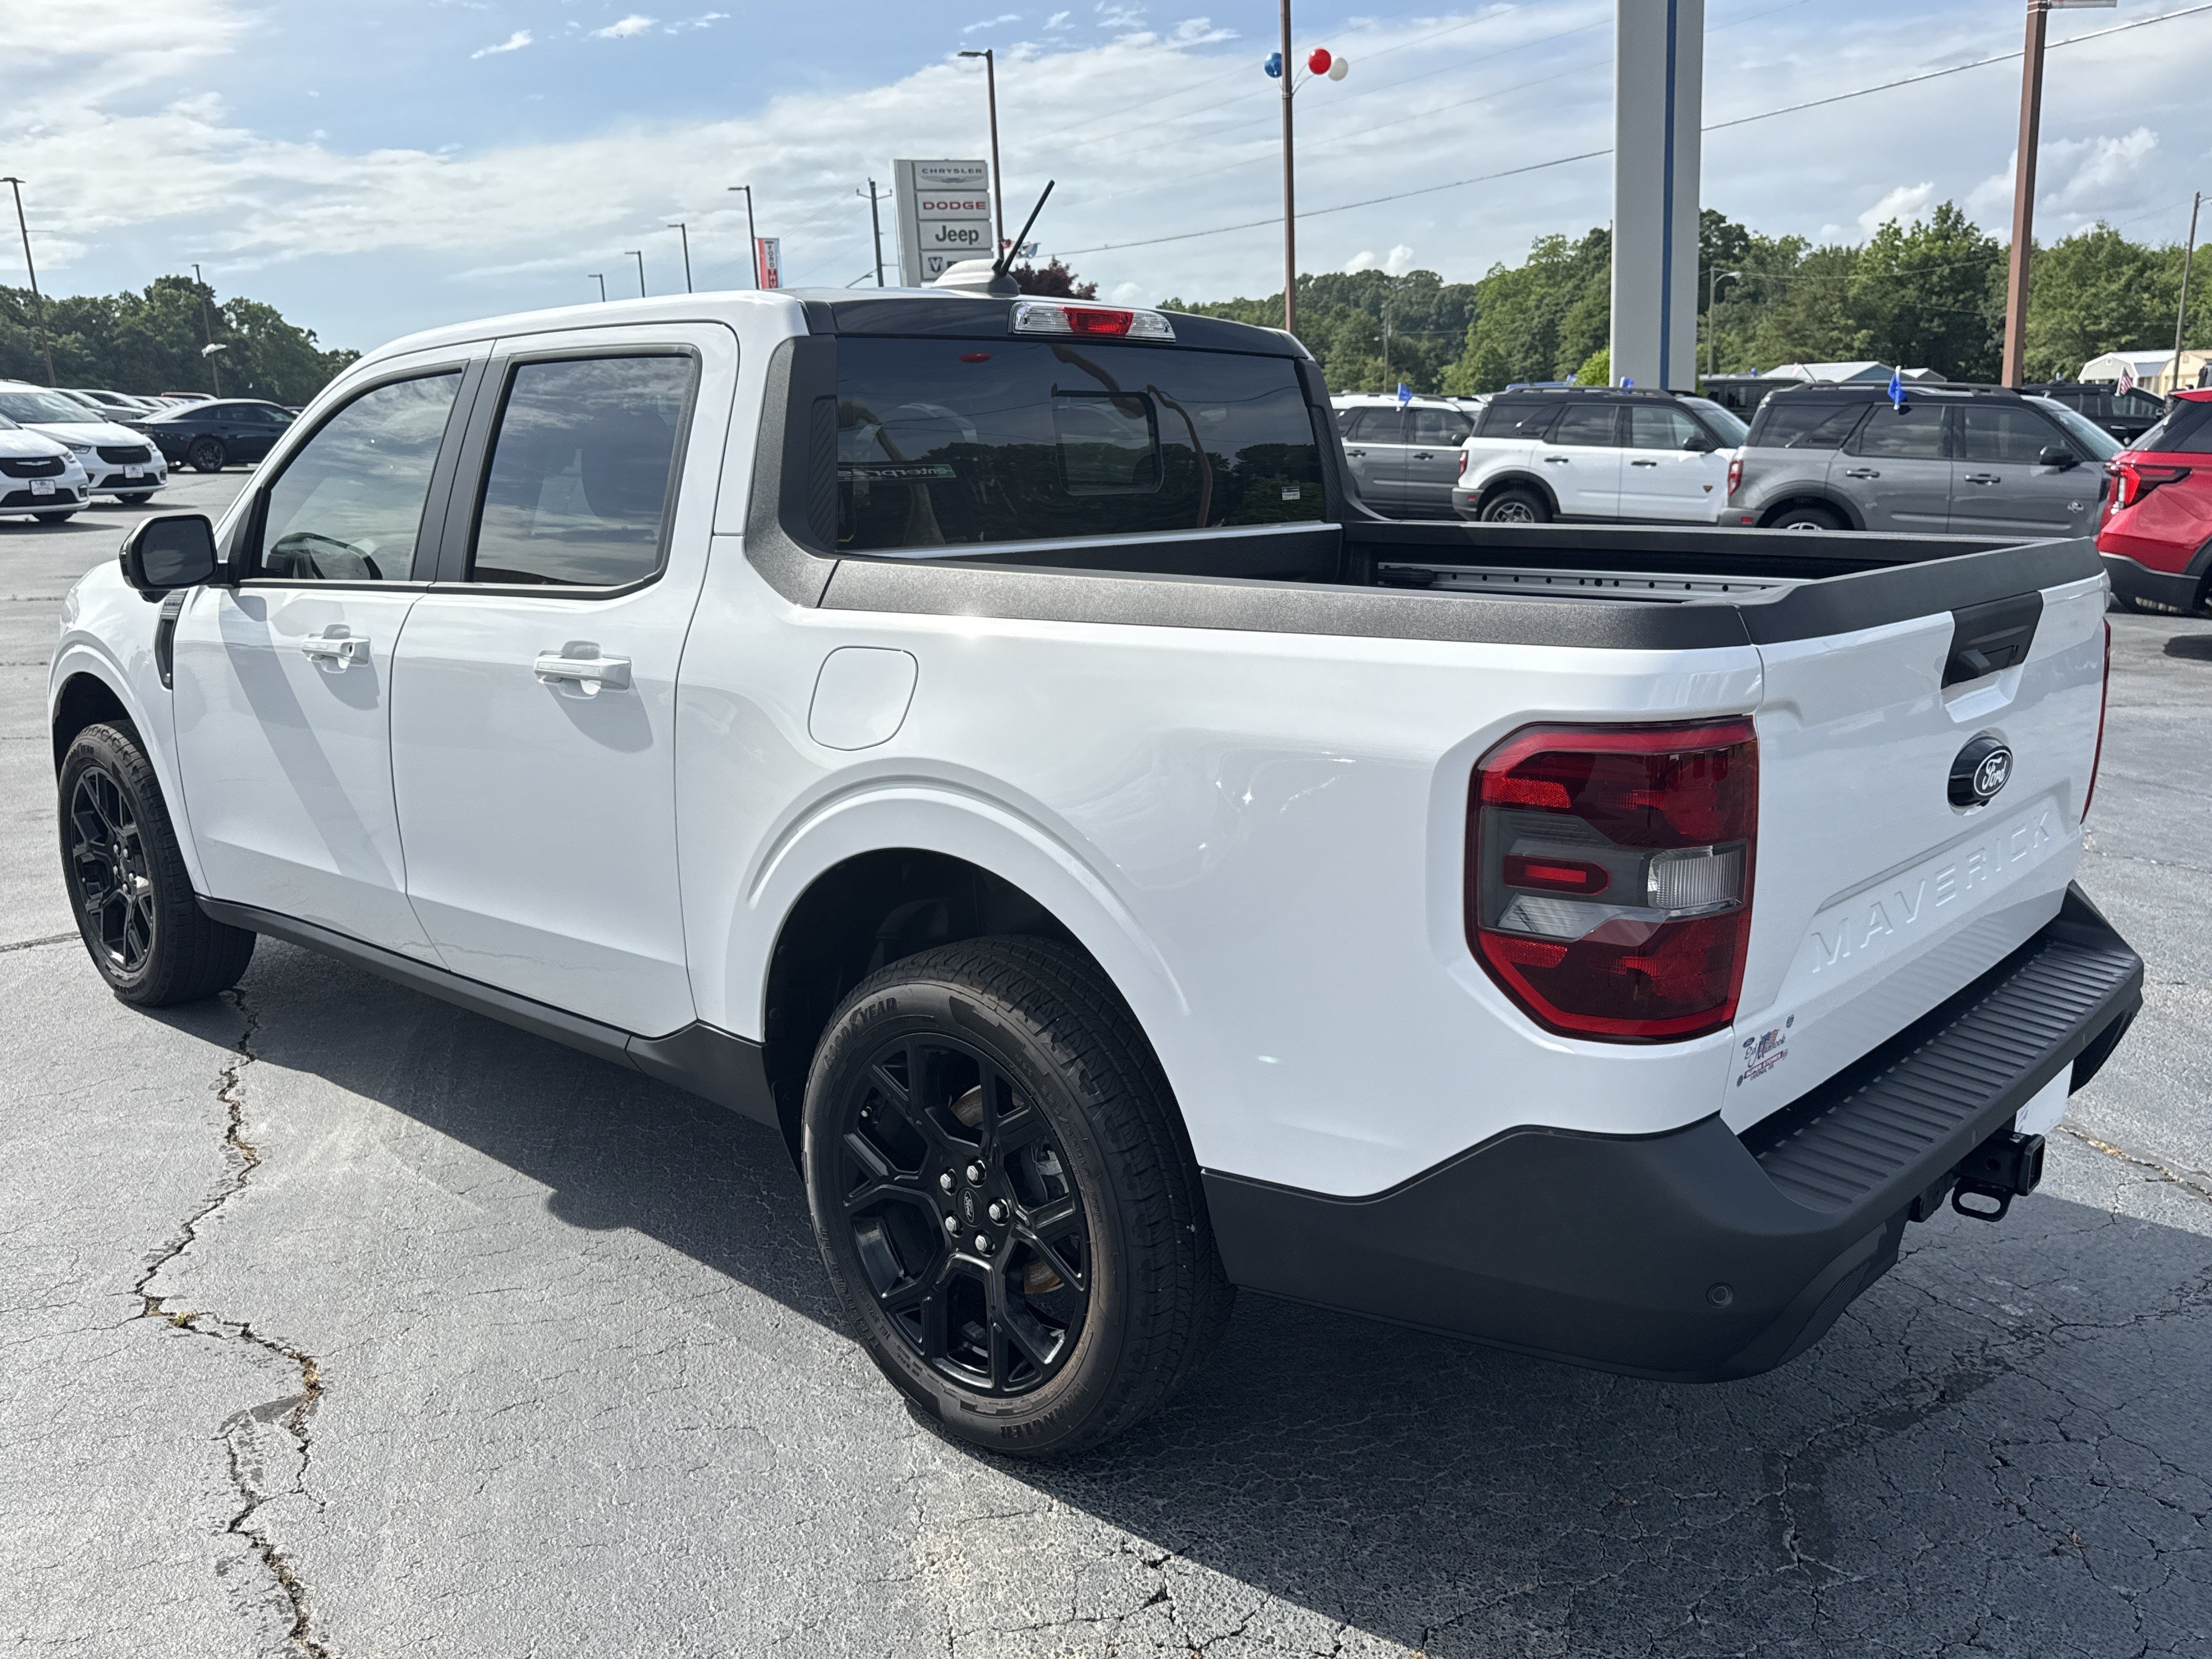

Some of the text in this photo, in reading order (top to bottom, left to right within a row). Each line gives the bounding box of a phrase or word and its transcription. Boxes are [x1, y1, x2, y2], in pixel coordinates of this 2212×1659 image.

[923, 201, 986, 210] DODGE
[935, 225, 979, 245] Jeep
[1980, 755, 2008, 791] Ford
[1810, 811, 2050, 974] MAVERICK
[823, 997, 899, 1070] GOODYEAR
[999, 1380, 1090, 1440] WRANGLER
